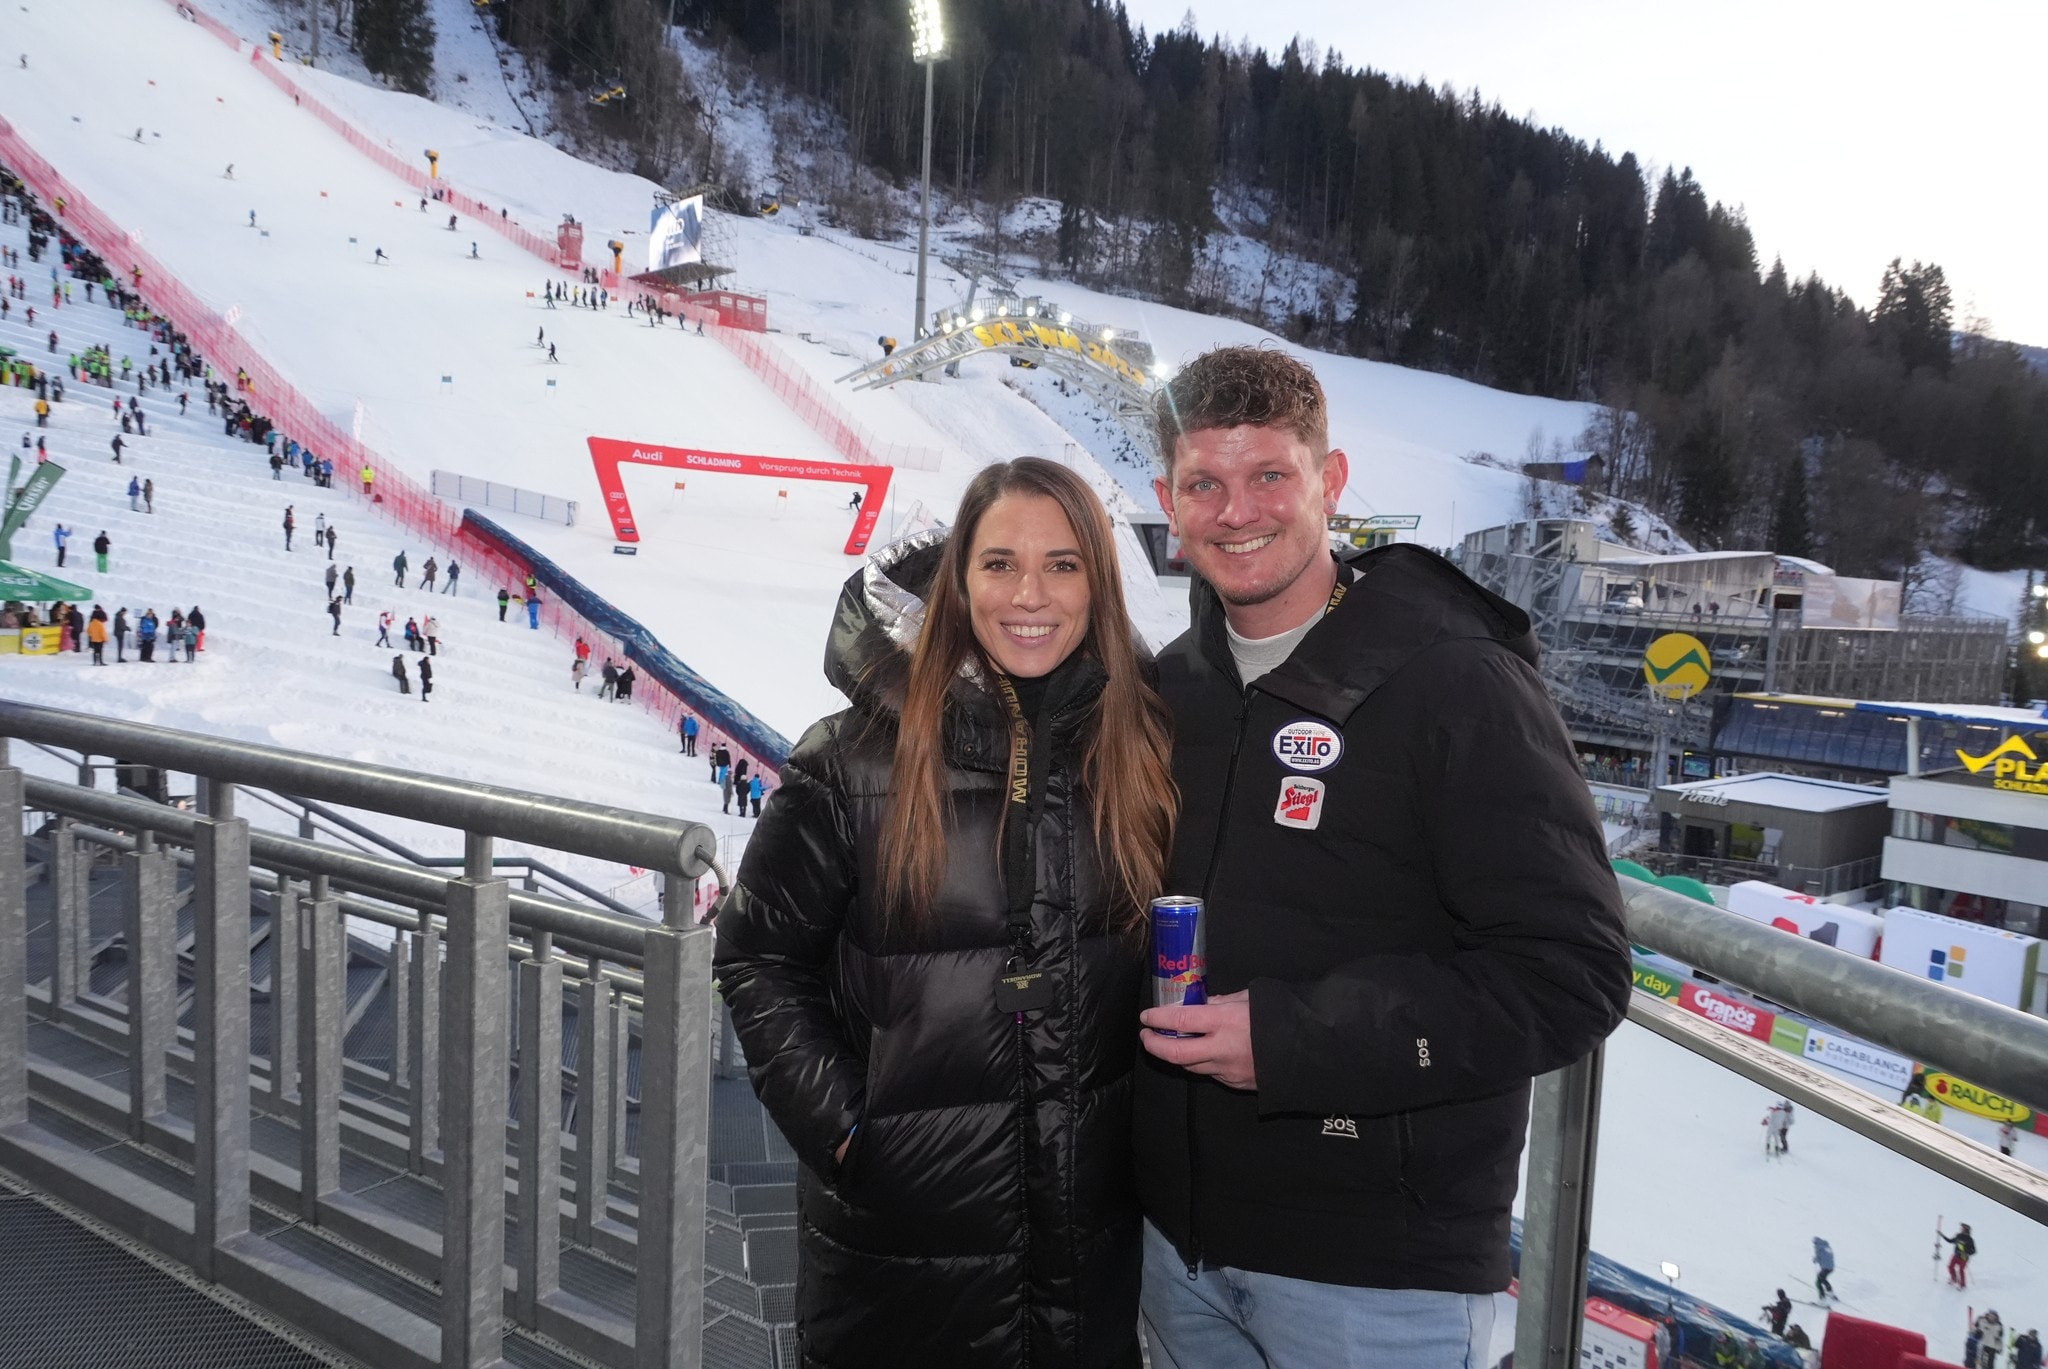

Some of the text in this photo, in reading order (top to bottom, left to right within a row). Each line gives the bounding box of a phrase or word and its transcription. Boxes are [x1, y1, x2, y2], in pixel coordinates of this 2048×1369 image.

[632, 449, 862, 478] Audi SCHLADMING Vorsprung durch Technik
[1281, 786, 1319, 811] Stiegl
[1679, 788, 1729, 807] Finale
[1158, 954, 1187, 971] Red
[1643, 974, 1671, 996] day
[1416, 1038, 1431, 1067] SOS
[1827, 1042, 1908, 1075] CASABLANCA
[1951, 1084, 2015, 1115] RAUCH
[1323, 1118, 1356, 1132] SOS
